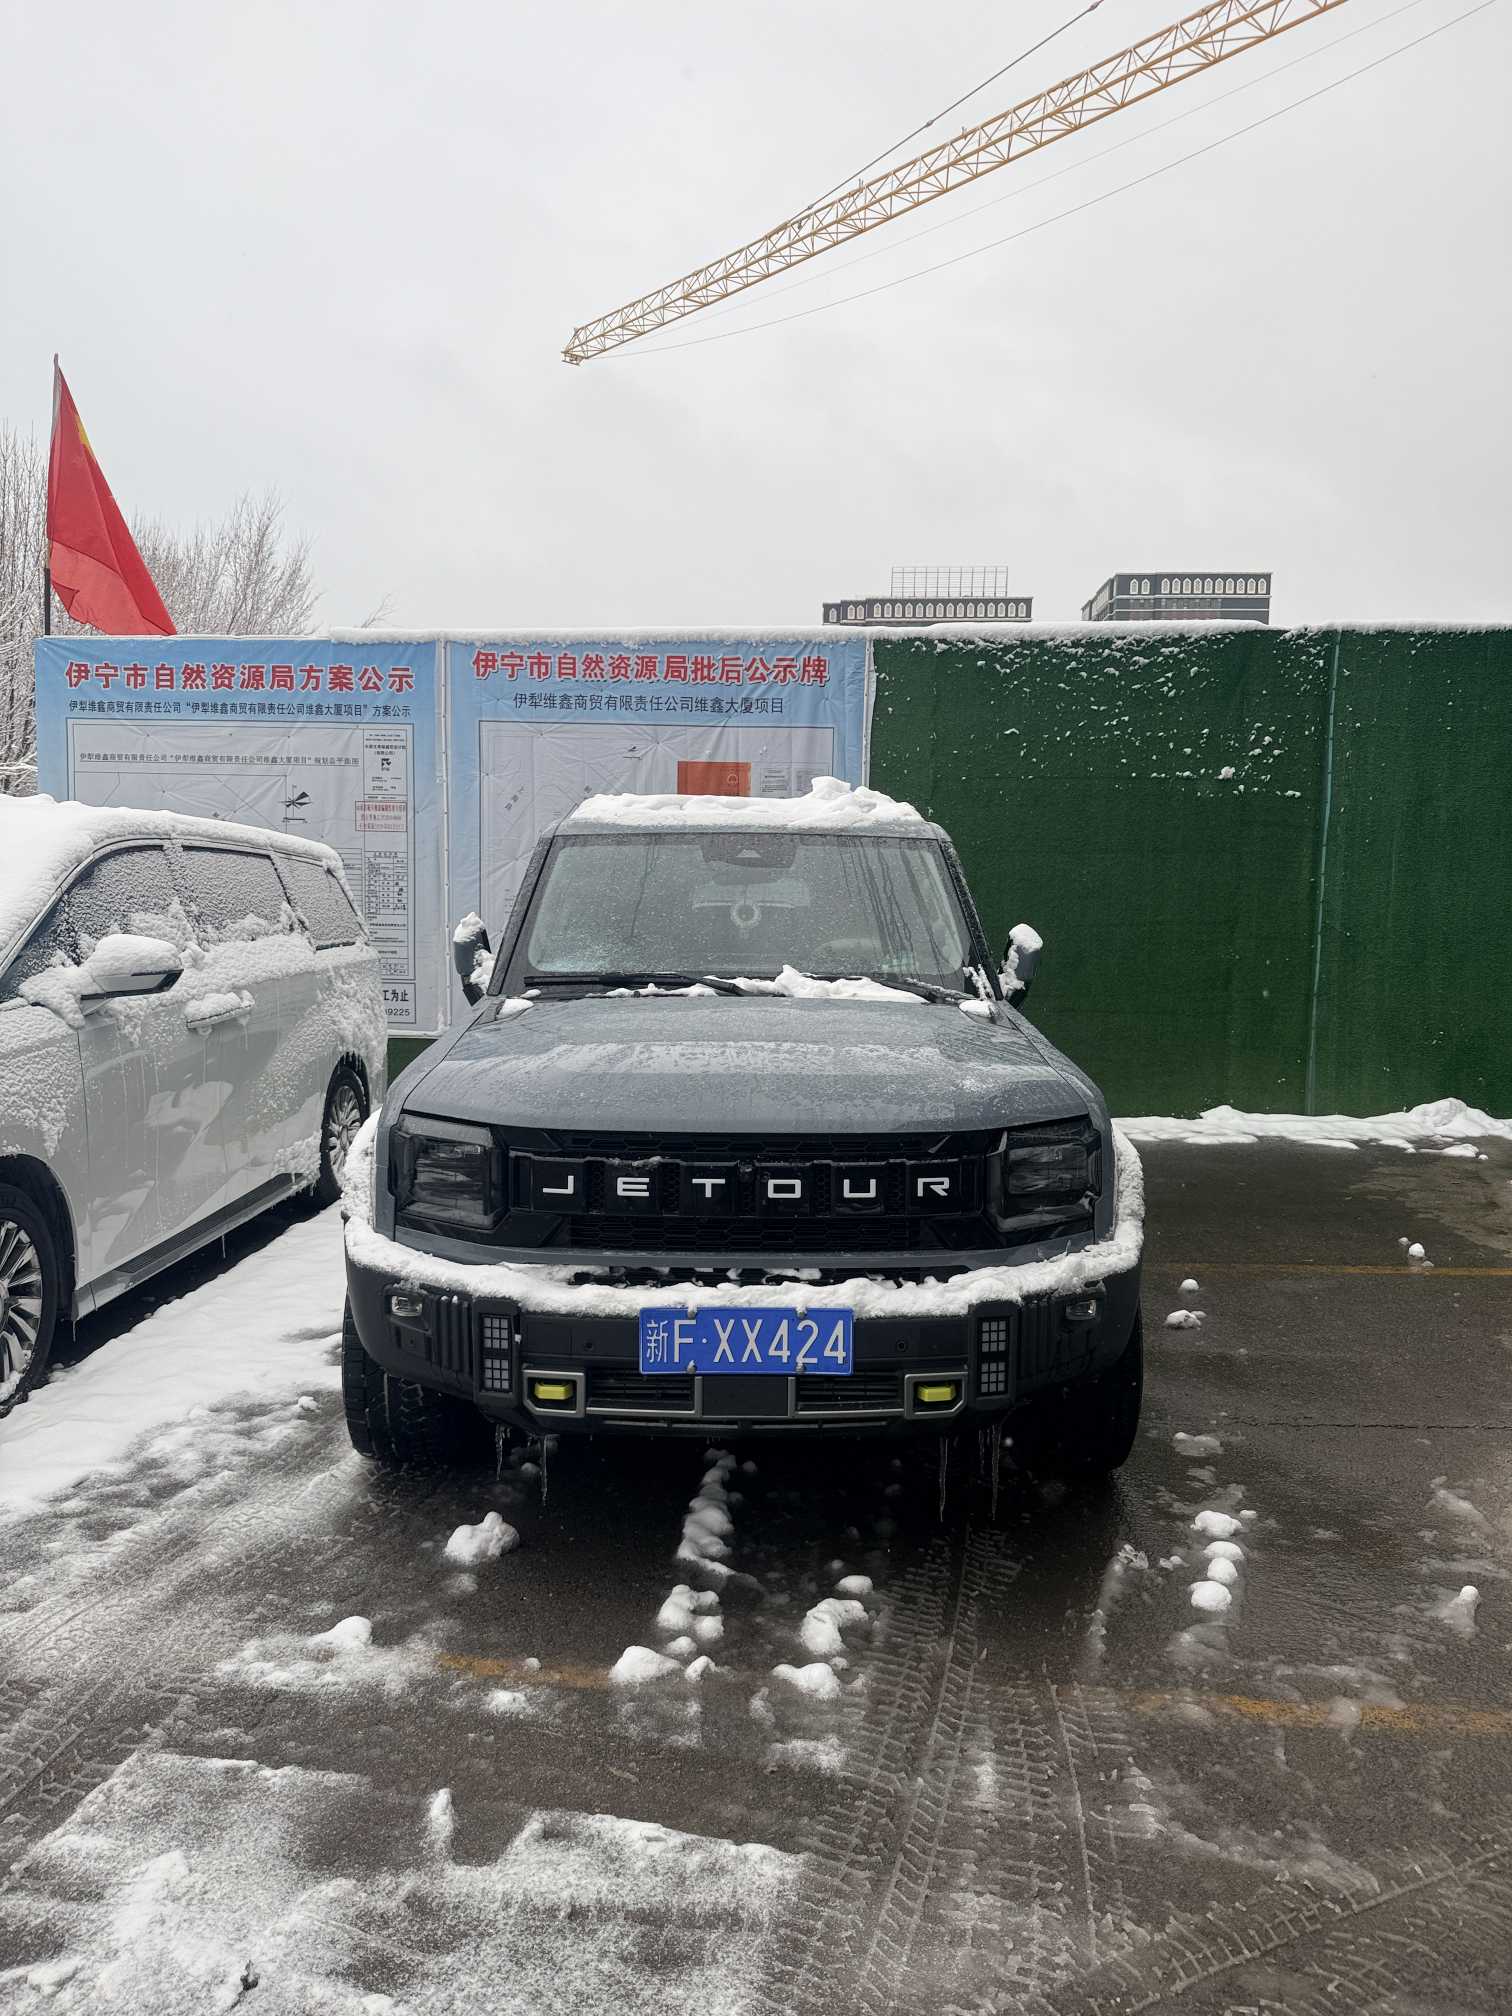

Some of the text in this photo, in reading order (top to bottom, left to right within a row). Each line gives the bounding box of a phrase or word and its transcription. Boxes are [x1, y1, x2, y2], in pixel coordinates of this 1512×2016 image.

[65, 661, 415, 693] 伊宁市自然资源局方案公示
[472, 650, 829, 686] 伊宁市自然资源局批后公示牌
[513, 692, 783, 714] 伊犁维鑫商贸有限责任公司维鑫大厦项目
[385, 1008, 410, 1016] 9225
[542, 1175, 950, 1198] JETOUR
